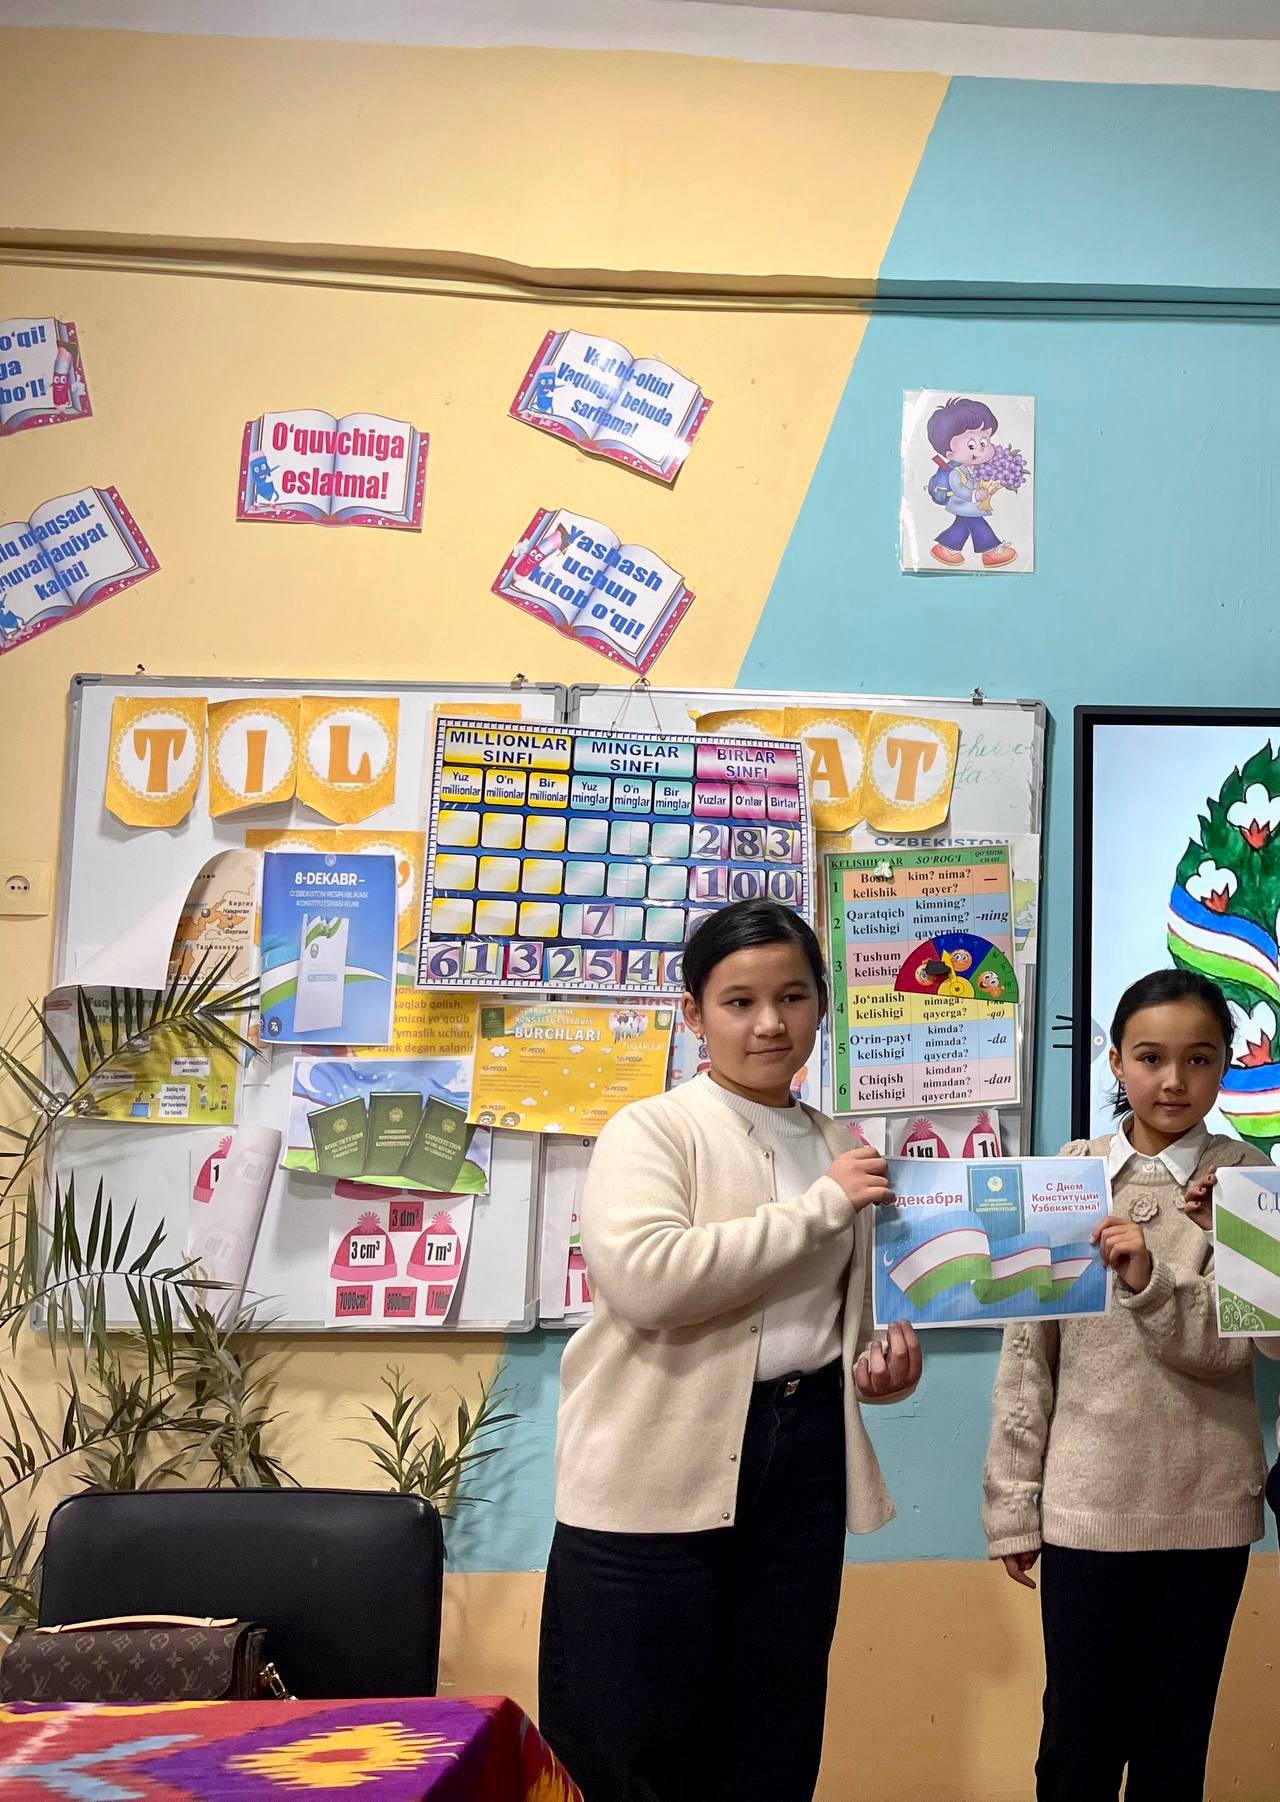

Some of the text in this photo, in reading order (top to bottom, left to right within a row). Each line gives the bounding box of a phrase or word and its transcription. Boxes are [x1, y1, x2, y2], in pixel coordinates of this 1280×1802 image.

[616, 361, 675, 399] bu-oltin!
[621, 391, 673, 427] behuda
[272, 422, 405, 461] O‘quvchiga
[281, 467, 389, 500] eslatma!
[18, 499, 96, 550] maqsad-
[568, 525, 663, 592] Yashash
[34, 560, 90, 601] kaliti!
[562, 556, 638, 607] uchun
[528, 566, 645, 640] kitob o‘qi!
[450, 730, 568, 752] MILLIONLAR
[591, 741, 680, 760] MINGLAR
[717, 747, 776, 765] BIRLAR
[482, 749, 533, 766] SINFI
[610, 758, 660, 774] SINFI
[725, 764, 769, 780] SINFI
[452, 770, 470, 784] Yuz
[539, 777, 556, 789] Bir
[442, 783, 481, 798] millionlar
[485, 786, 524, 801] millionlar
[581, 781, 598, 793] Yuz
[664, 786, 680, 798] Bir
[529, 789, 567, 803] millionlar
[572, 792, 609, 807] minglar
[614, 794, 651, 809] minglar
[697, 793, 727, 807] Yuzlar
[655, 797, 691, 812] minglar
[770, 796, 797, 810] Birlar
[908, 869, 971, 881] kim? nima?
[833, 882, 839, 893] 1
[853, 889, 897, 899] kelishik
[922, 884, 958, 896] qayer?
[915, 898, 966, 910] kimning?
[585, 906, 611, 935] 7
[846, 909, 905, 922] Qaratqich
[913, 912, 970, 924] nimaning?
[976, 911, 1009, 923] -ning
[834, 918, 841, 930] 2
[853, 924, 900, 935] kelishigi
[854, 952, 901, 963] Tushum
[834, 961, 842, 972] 3
[836, 1003, 844, 1014] 4
[856, 1009, 904, 1021] kelishigi
[923, 1008, 967, 1020] qayerga?
[986, 1008, 1005, 1019] -qa)
[514, 1027, 600, 1041] BURCHLARI
[928, 1024, 964, 1035] kimda?
[925, 1037, 967, 1048] nimada?
[987, 1034, 1007, 1044] -da
[838, 1044, 846, 1055] 5
[857, 1049, 905, 1061] kelishigi
[924, 1049, 969, 1062] qayerda?
[925, 1064, 968, 1076] kimdan?
[859, 1074, 904, 1086] Chiqish
[923, 1077, 971, 1088] nimadan?
[984, 1074, 1012, 1085] -dan
[839, 1085, 847, 1096] 6
[858, 1089, 906, 1101] kelishigi
[921, 1089, 973, 1102] qayerdan?
[1056, 1182, 1084, 1192] Днем
[896, 1192, 963, 1207] декабря
[1031, 1193, 1099, 1203] Конституции
[1031, 1202, 1100, 1213] Узбекистана!
[392, 1209, 398, 1227] 3
[351, 1241, 358, 1259] 3
[427, 1242, 434, 1261] 7
